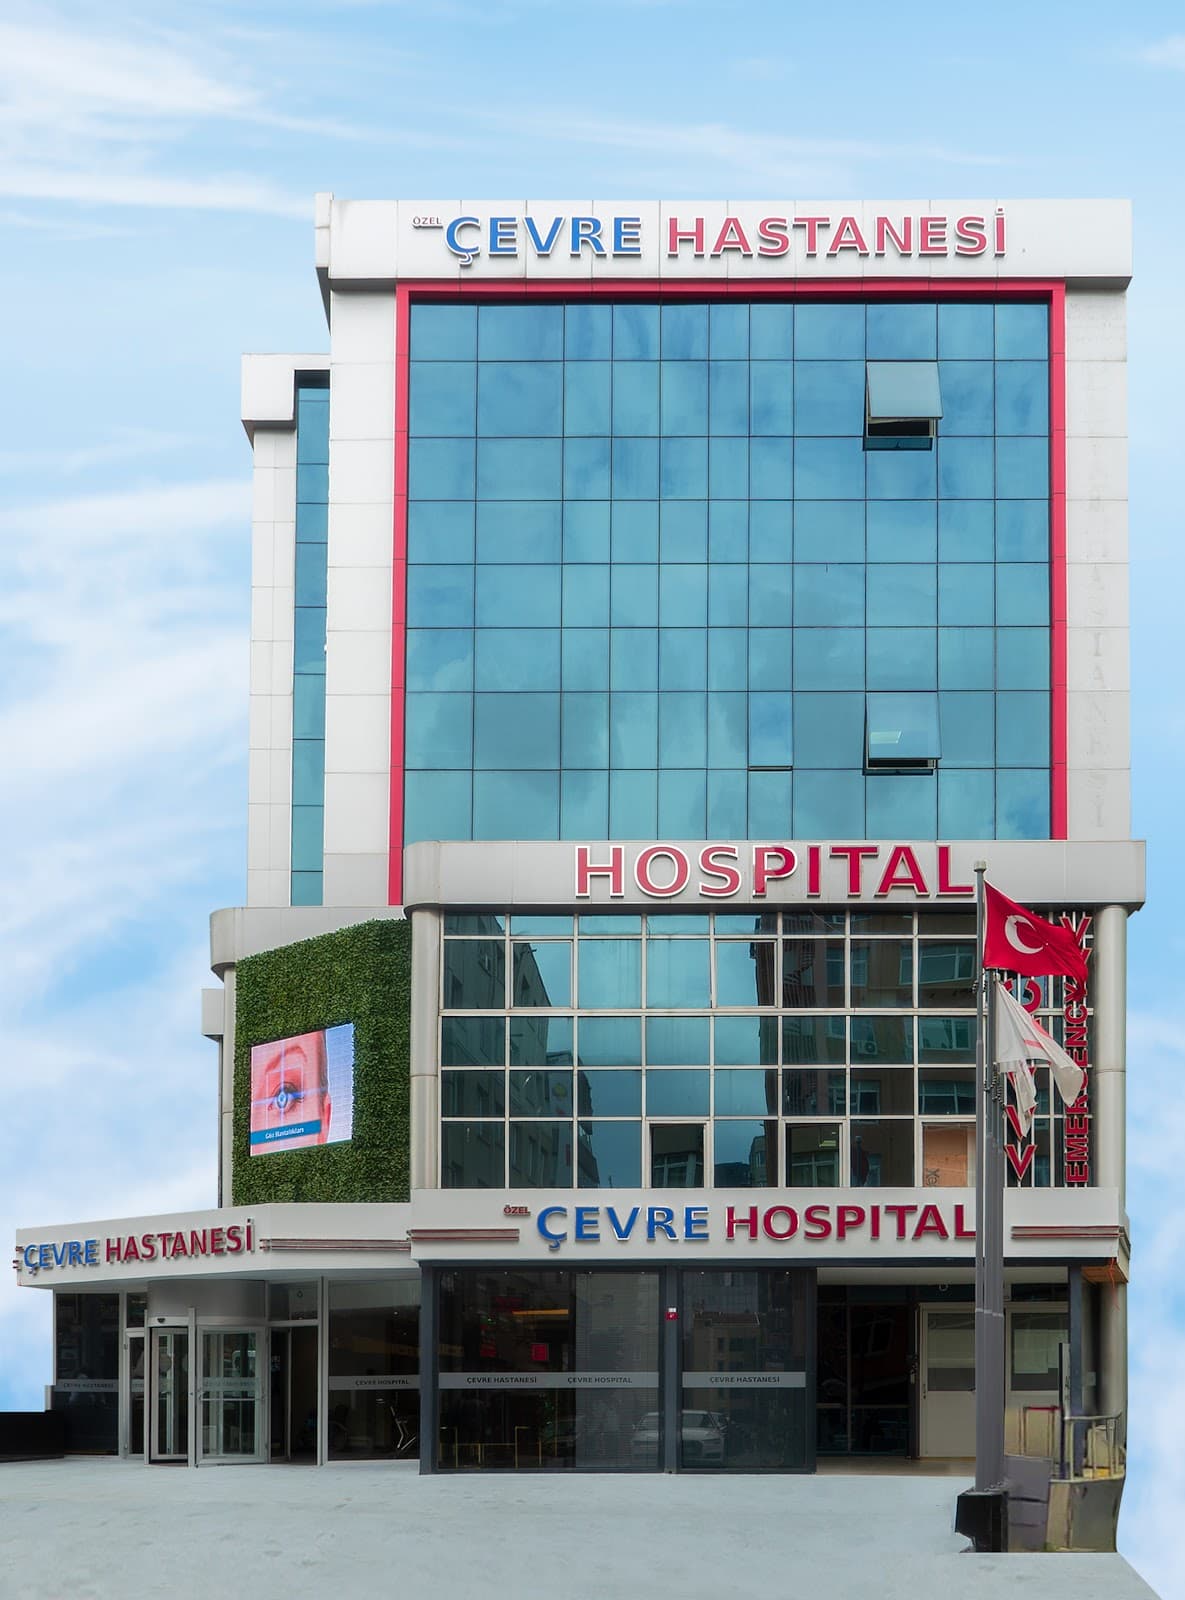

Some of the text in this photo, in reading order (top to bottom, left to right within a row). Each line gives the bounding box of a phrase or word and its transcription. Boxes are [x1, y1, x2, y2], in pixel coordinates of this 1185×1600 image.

[412, 215, 443, 226] ÖZEL
[445, 208, 1006, 266] ÇEVRE HASTANESİ
[575, 845, 974, 898] HOSPITAL
[1064, 982, 1089, 1183] EMERENCY
[503, 1205, 531, 1216] ÖZEL
[536, 1204, 977, 1250] ÇEVRE HOSPITAL
[24, 1218, 253, 1275] ÇEVRE HASTANESİ
[466, 1375, 537, 1384] ÇEVRE HASTANESİ
[567, 1376, 633, 1384] ÇEVRE HOSPITAL
[710, 1375, 780, 1384] ÇEVRE HASTANESİ
